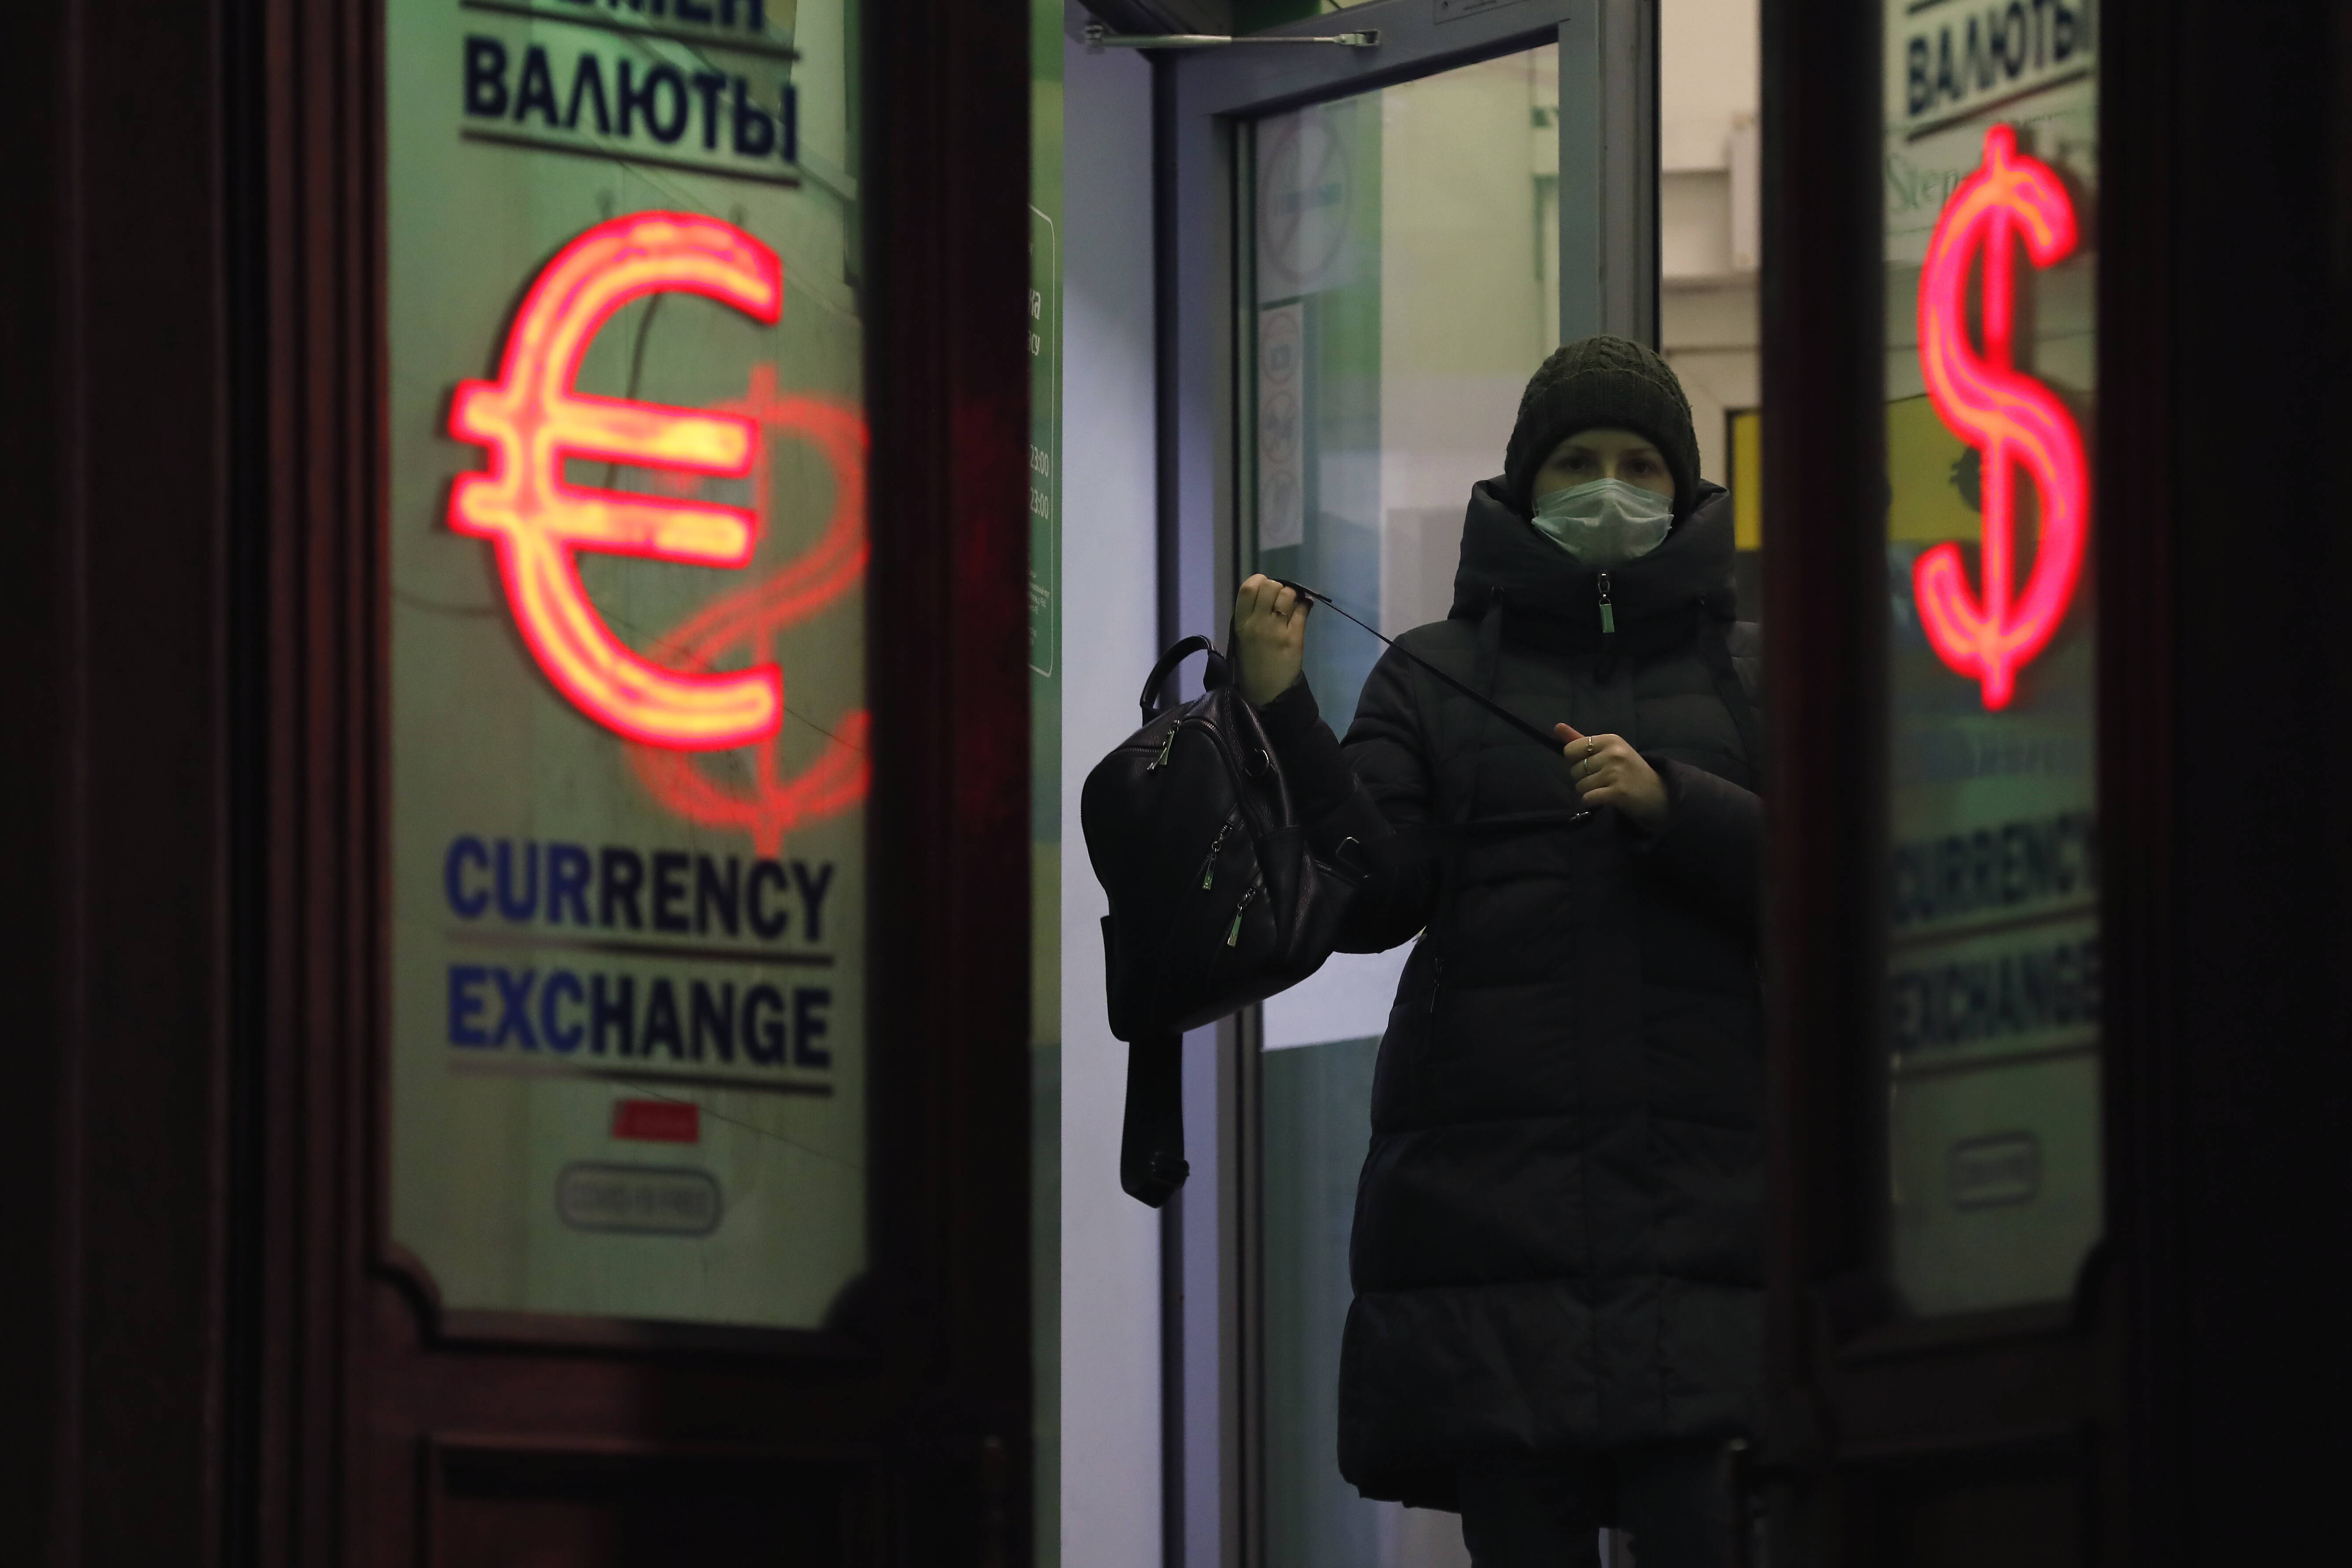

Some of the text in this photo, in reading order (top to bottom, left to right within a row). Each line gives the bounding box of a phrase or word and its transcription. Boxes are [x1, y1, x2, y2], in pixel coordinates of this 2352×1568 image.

[463, 33, 798, 164] ВАЛЮТЫ
[1030, 444, 1049, 478] 23:00
[1030, 486, 1049, 520] 23:00
[444, 833, 833, 943] CURRENCY
[447, 963, 832, 1068] EXCHANGE
